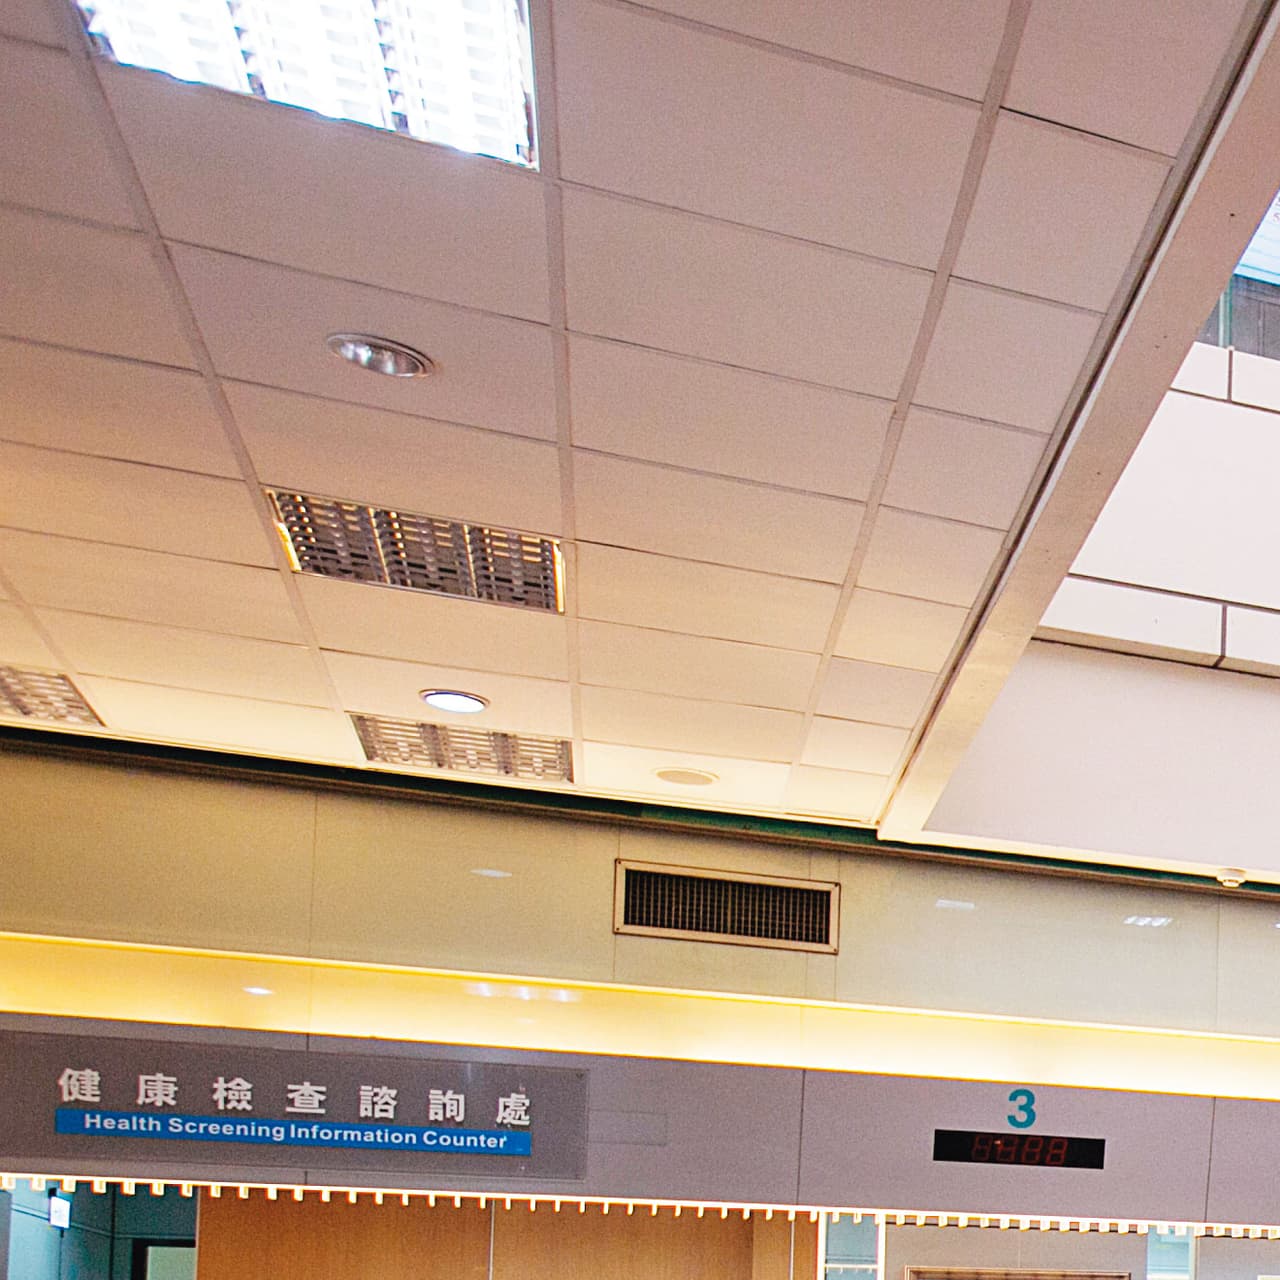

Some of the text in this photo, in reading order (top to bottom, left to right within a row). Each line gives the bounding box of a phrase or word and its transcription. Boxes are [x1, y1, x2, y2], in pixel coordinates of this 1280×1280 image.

[58, 1067, 531, 1126] 健康檢查諮詢處
[1007, 1088, 1037, 1128] 3
[84, 1113, 508, 1149] Health Screening Information Counter
